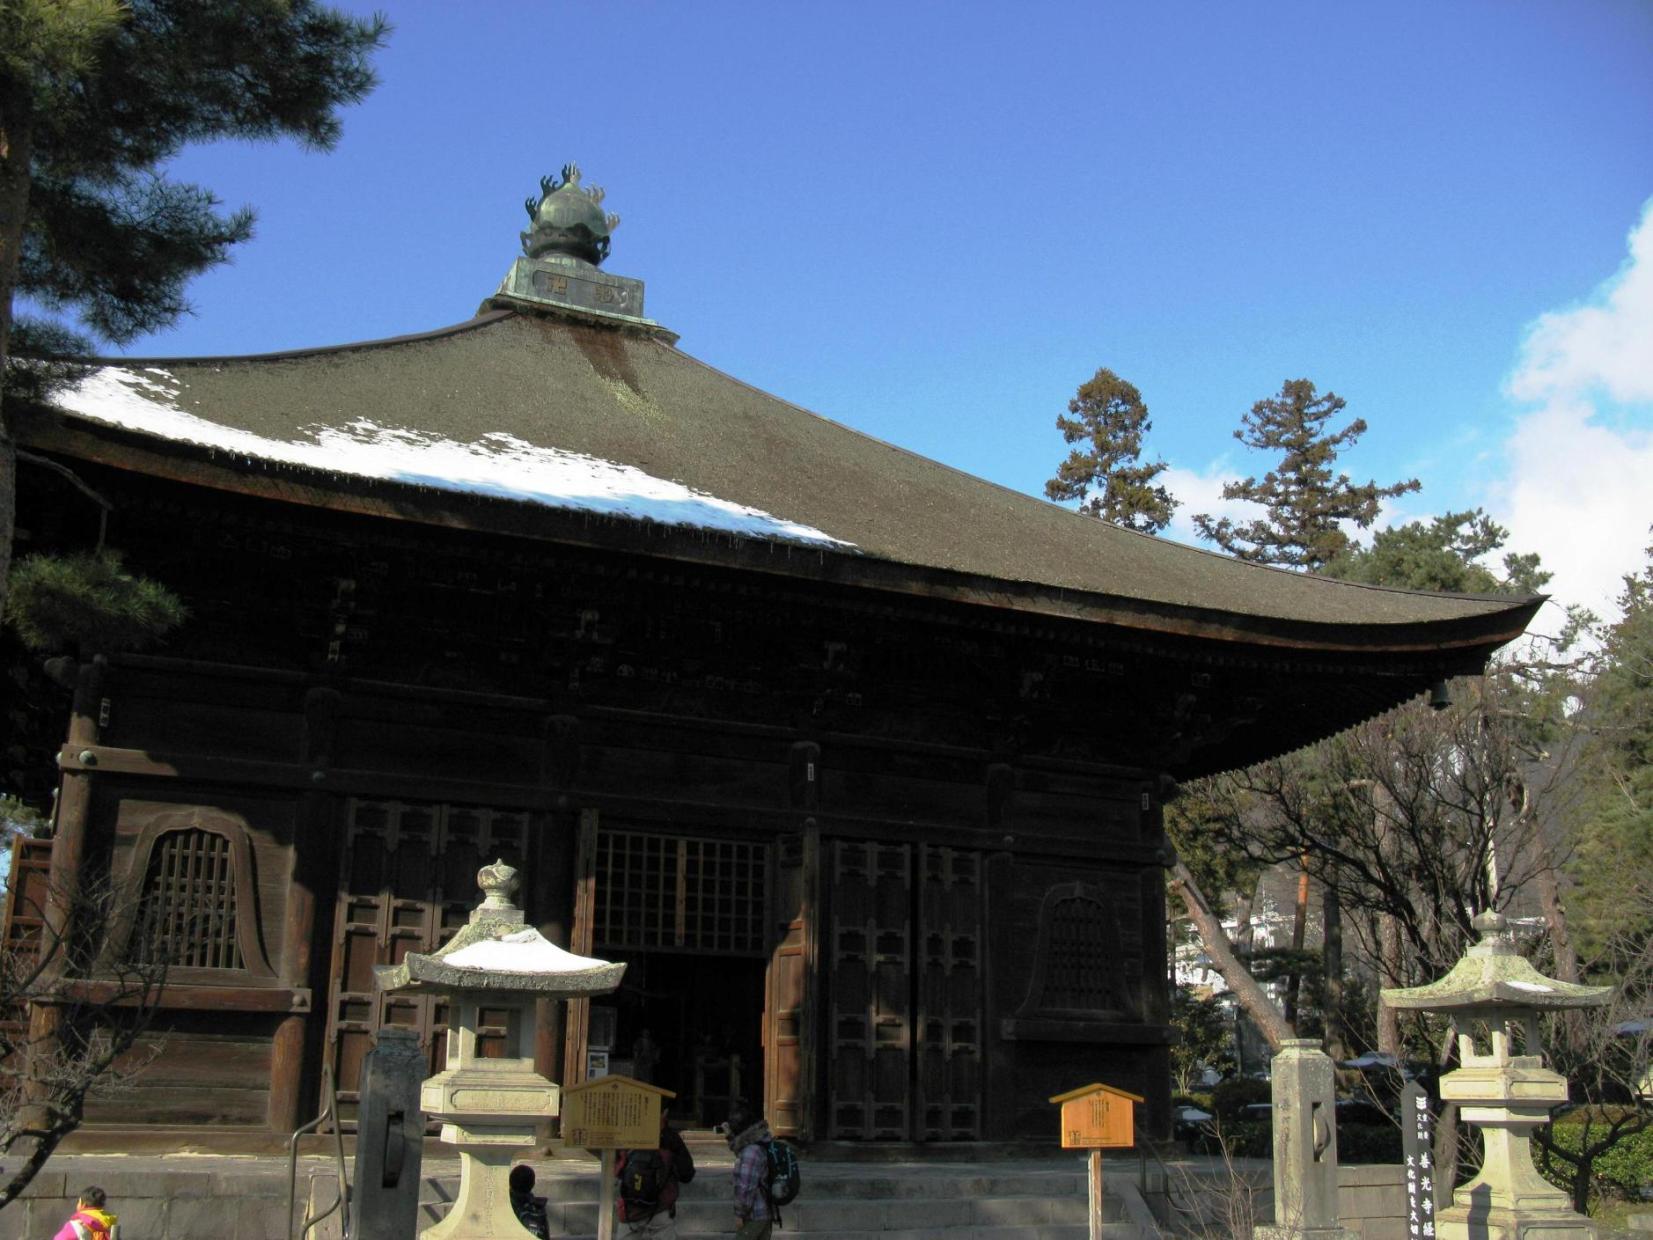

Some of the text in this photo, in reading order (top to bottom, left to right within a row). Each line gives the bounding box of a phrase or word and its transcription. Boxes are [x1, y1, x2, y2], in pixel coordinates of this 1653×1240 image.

[1406, 1154, 1419, 1240] 文化財を大切
